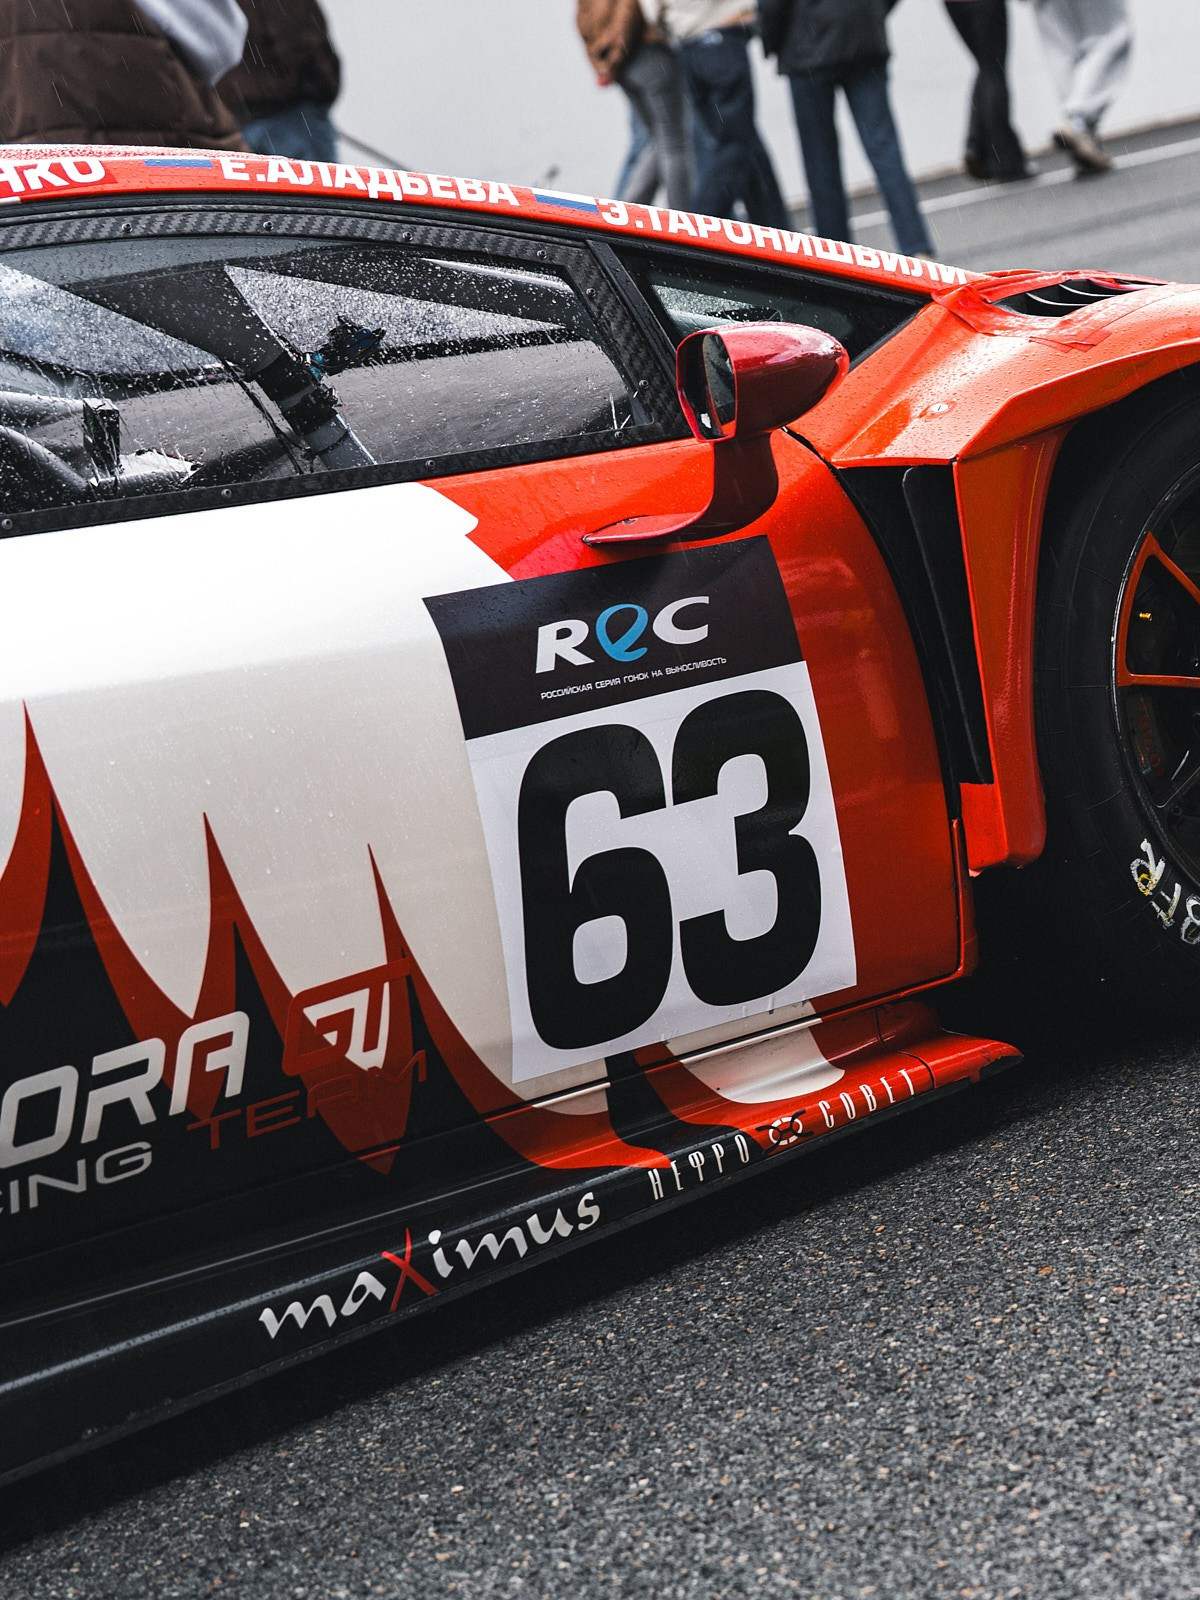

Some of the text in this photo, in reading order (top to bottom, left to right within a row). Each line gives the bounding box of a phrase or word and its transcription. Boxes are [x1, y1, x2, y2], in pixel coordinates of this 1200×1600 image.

[601, 198, 967, 285] Э.ТАРОНИШВИЛИ
[540, 657, 727, 699] РОССИЙСКАЯ СЕРИЯ ГОНОК НА ВЫНОСЛИВОСТЬ
[518, 689, 822, 1050] 63
[0, 1141, 153, 1214] ING
[648, 1068, 915, 1200] НЕФРО СОВЕТ
